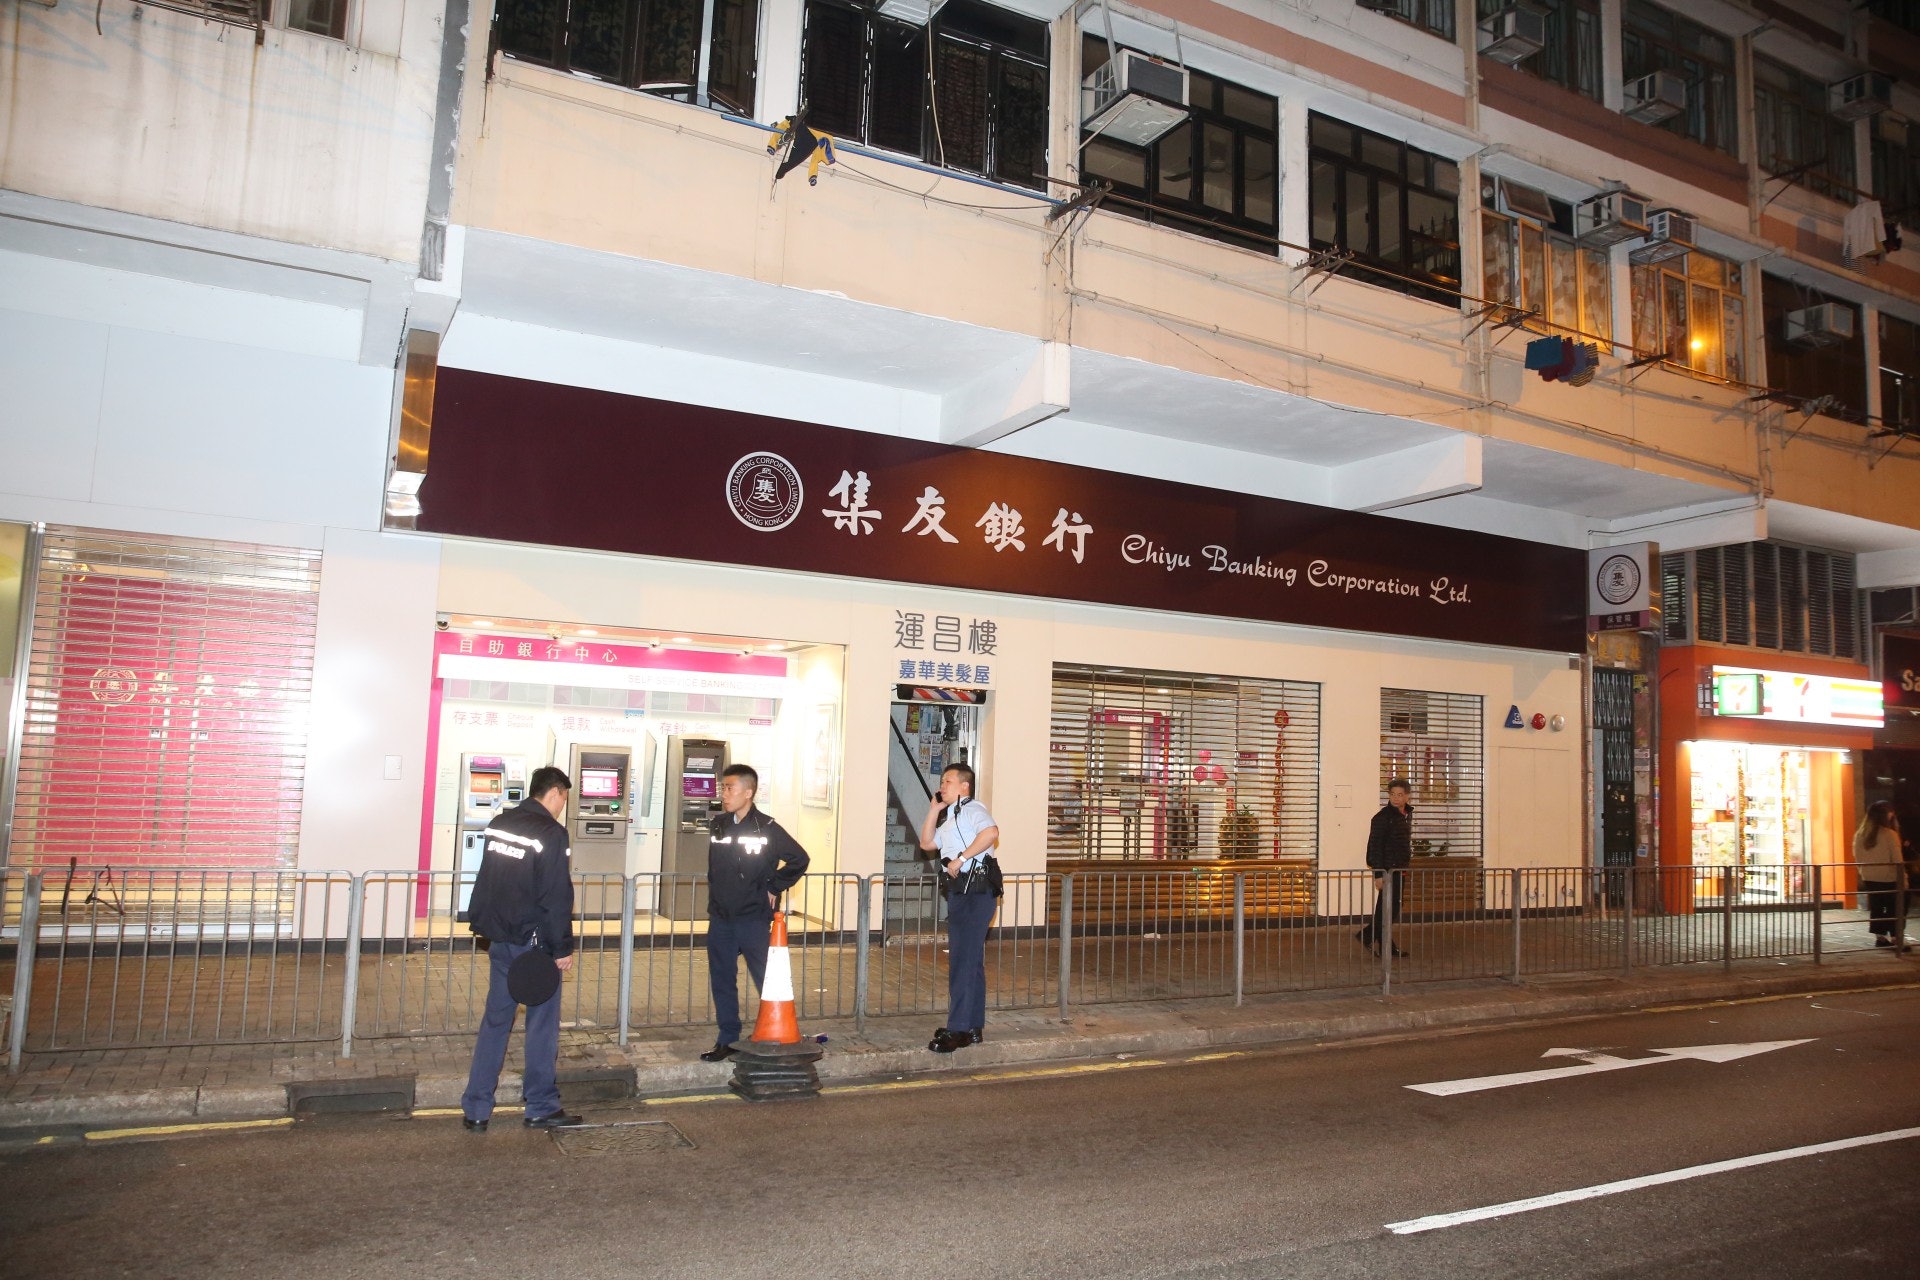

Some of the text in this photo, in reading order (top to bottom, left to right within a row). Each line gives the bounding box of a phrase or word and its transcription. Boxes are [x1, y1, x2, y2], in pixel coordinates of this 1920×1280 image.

[731, 457, 799, 514] CHIYU BANKING CORPORATION LIMITED
[743, 512, 784, 526] HONG KONG
[822, 469, 1094, 565] 集友銀行
[1121, 534, 1471, 605] Chiyu Banking Corporation Ltd.
[894, 609, 998, 656] 運昌樓
[459, 639, 618, 663] 自助銀行中心
[899, 659, 990, 685] 嘉華美髮屋
[453, 711, 499, 726] 存支票
[562, 716, 591, 732] 提款
